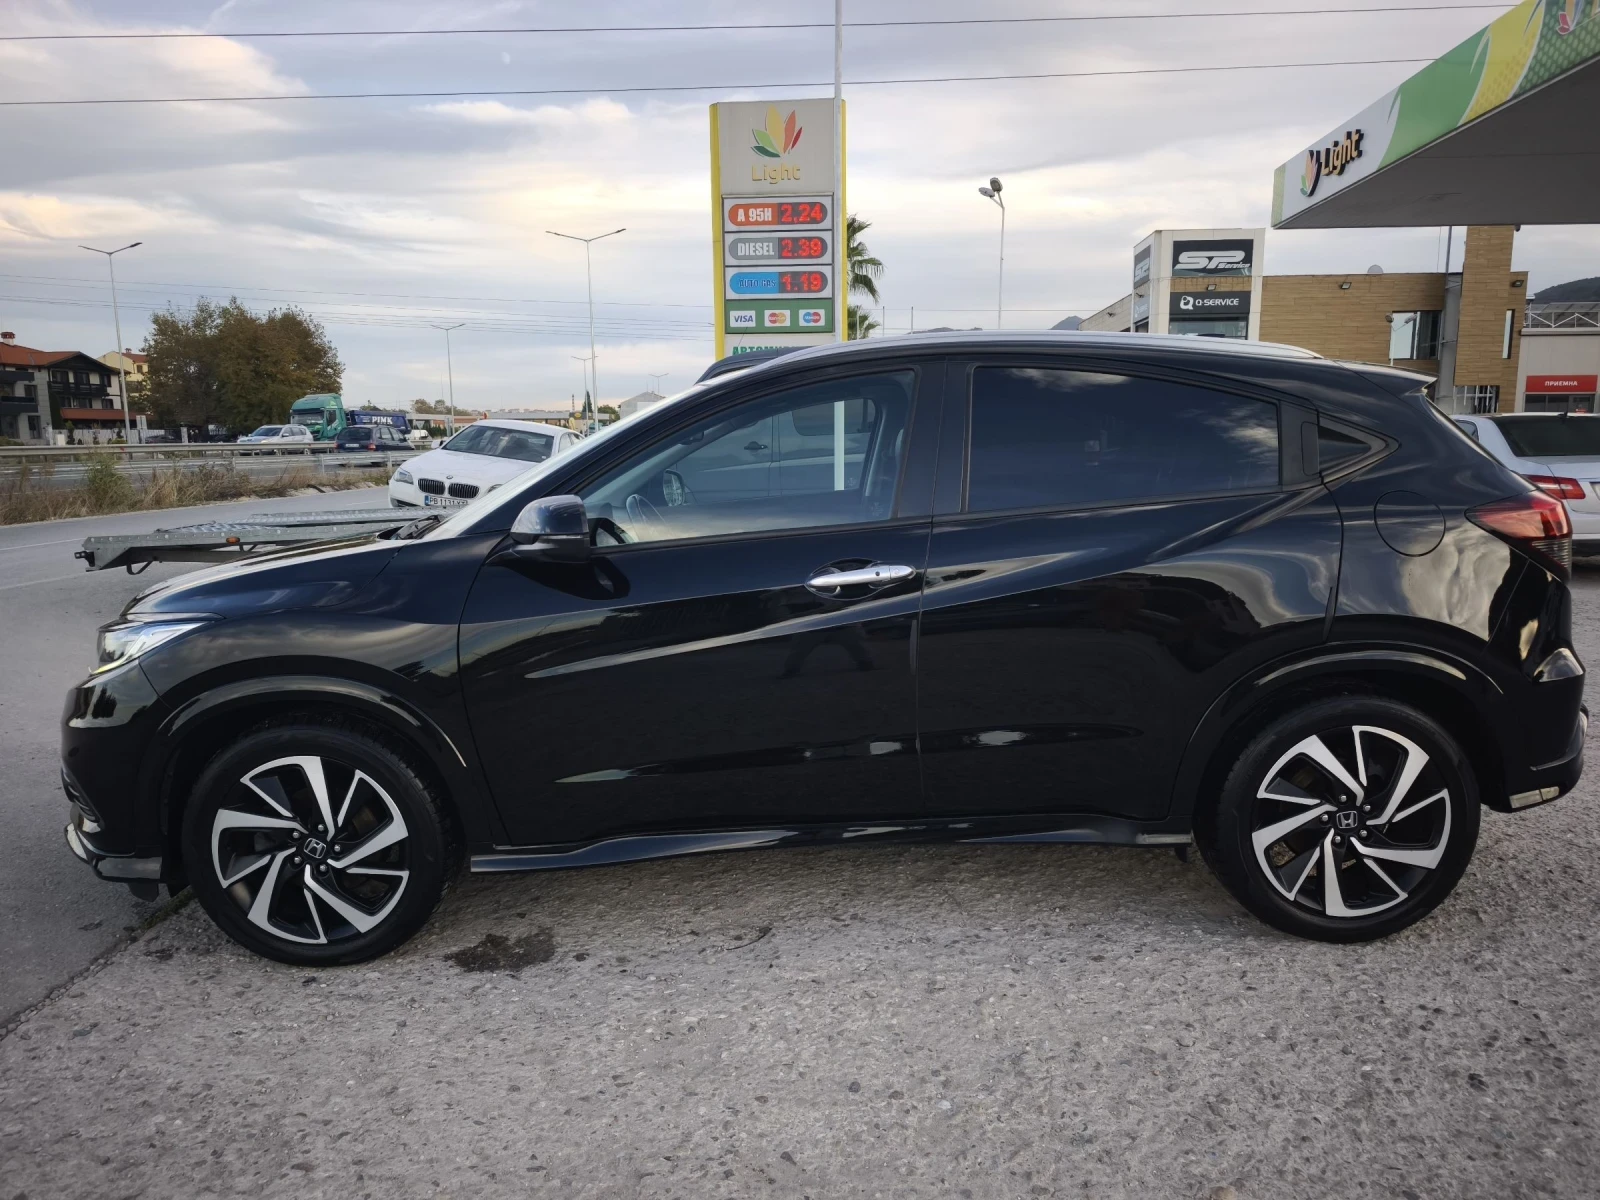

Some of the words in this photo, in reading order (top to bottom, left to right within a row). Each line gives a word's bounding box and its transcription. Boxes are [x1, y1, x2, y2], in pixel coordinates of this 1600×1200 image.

[1321, 129, 1364, 176] Light
[751, 163, 801, 184] Light
[781, 203, 823, 223] 2.24
[737, 242, 775, 256] DIESEL
[781, 239, 822, 257] 2.39
[782, 273, 822, 291] 1.19
[734, 315, 754, 323] VISA
[371, 415, 393, 425] PIMK
